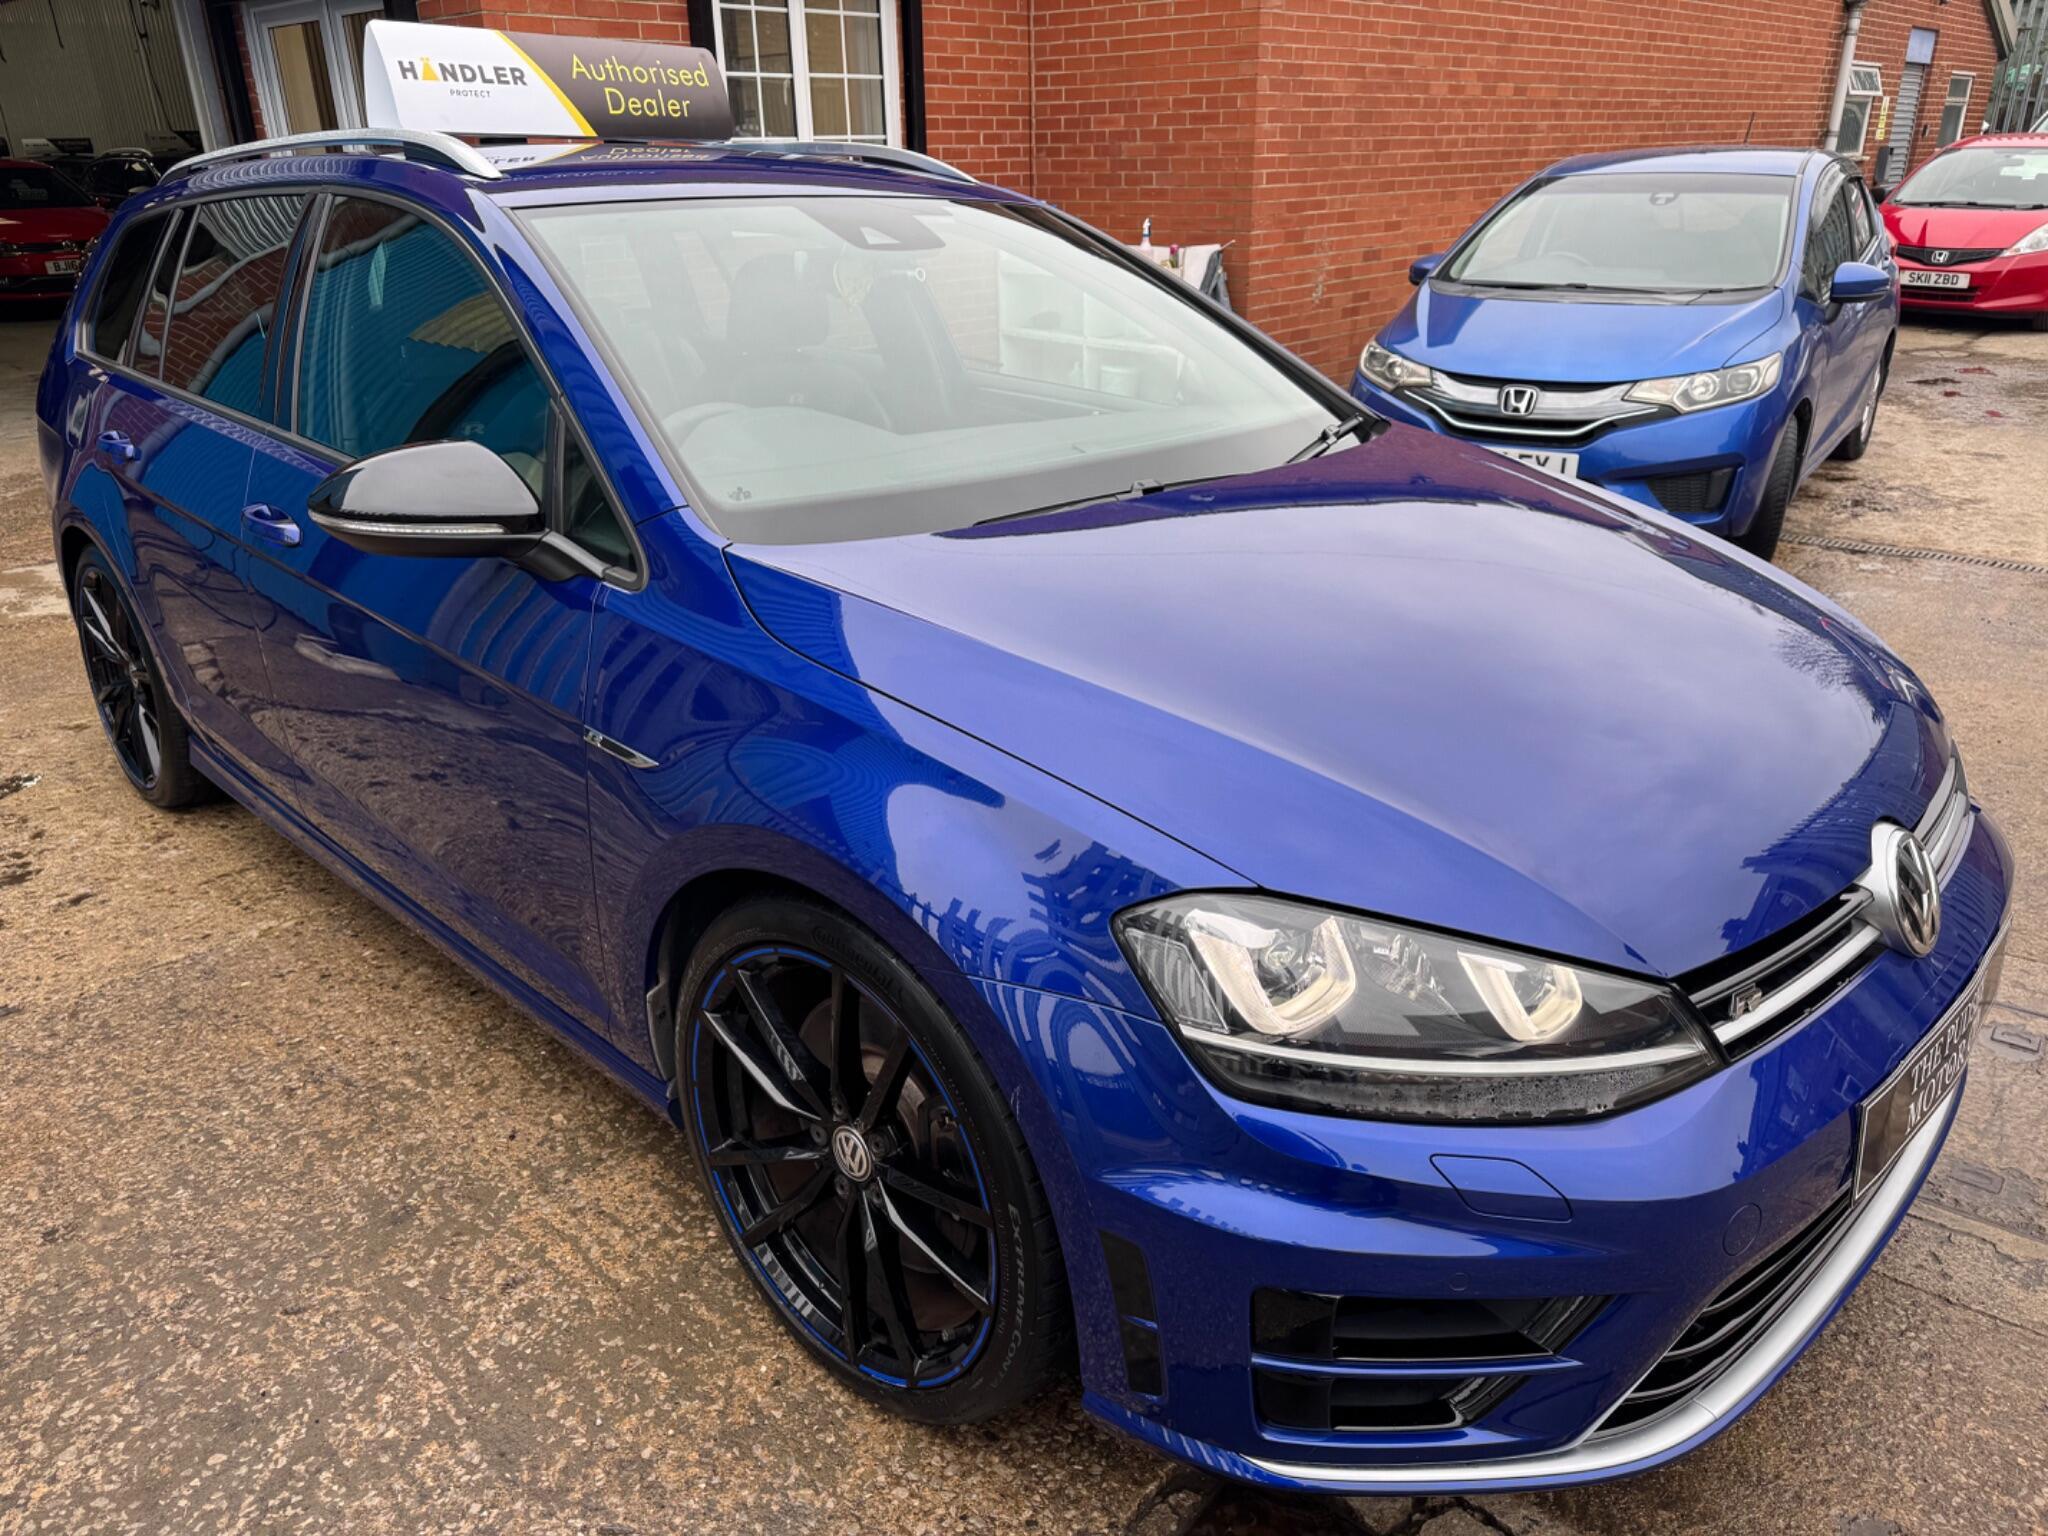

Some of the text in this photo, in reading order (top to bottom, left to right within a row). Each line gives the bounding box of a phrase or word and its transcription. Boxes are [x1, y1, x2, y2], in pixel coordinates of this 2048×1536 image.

[571, 53, 710, 88] Authorised
[449, 88, 491, 99] PROTECT
[604, 87, 690, 117] Dealer
[1934, 273, 1960, 286] ZBD
[1911, 1037, 1944, 1095] THE
